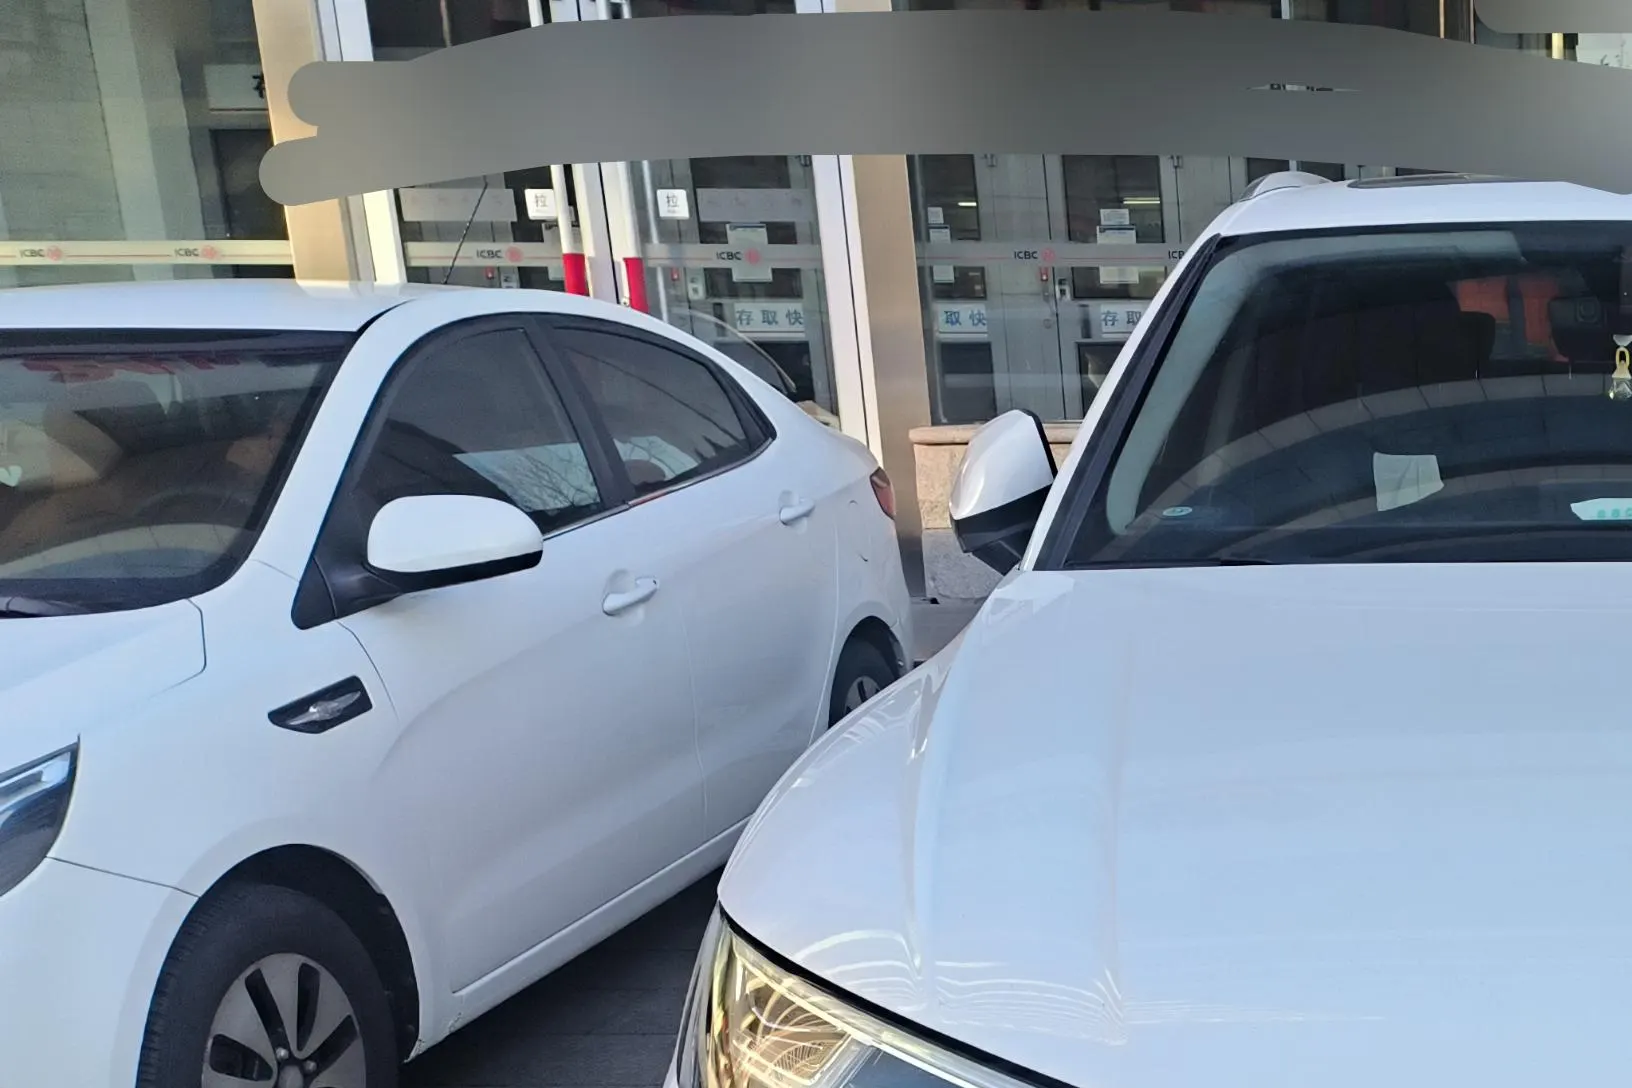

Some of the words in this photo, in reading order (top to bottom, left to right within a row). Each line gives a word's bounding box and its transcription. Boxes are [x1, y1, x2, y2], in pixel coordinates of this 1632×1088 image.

[534, 193, 549, 208] 拉
[666, 193, 681, 208] 拉
[19, 249, 45, 258] ICBC
[174, 248, 199, 257] ICBC
[476, 249, 503, 258] ICBC
[716, 251, 743, 260] ICBC
[1013, 250, 1038, 260] ICBC
[735, 308, 804, 325] 存取快
